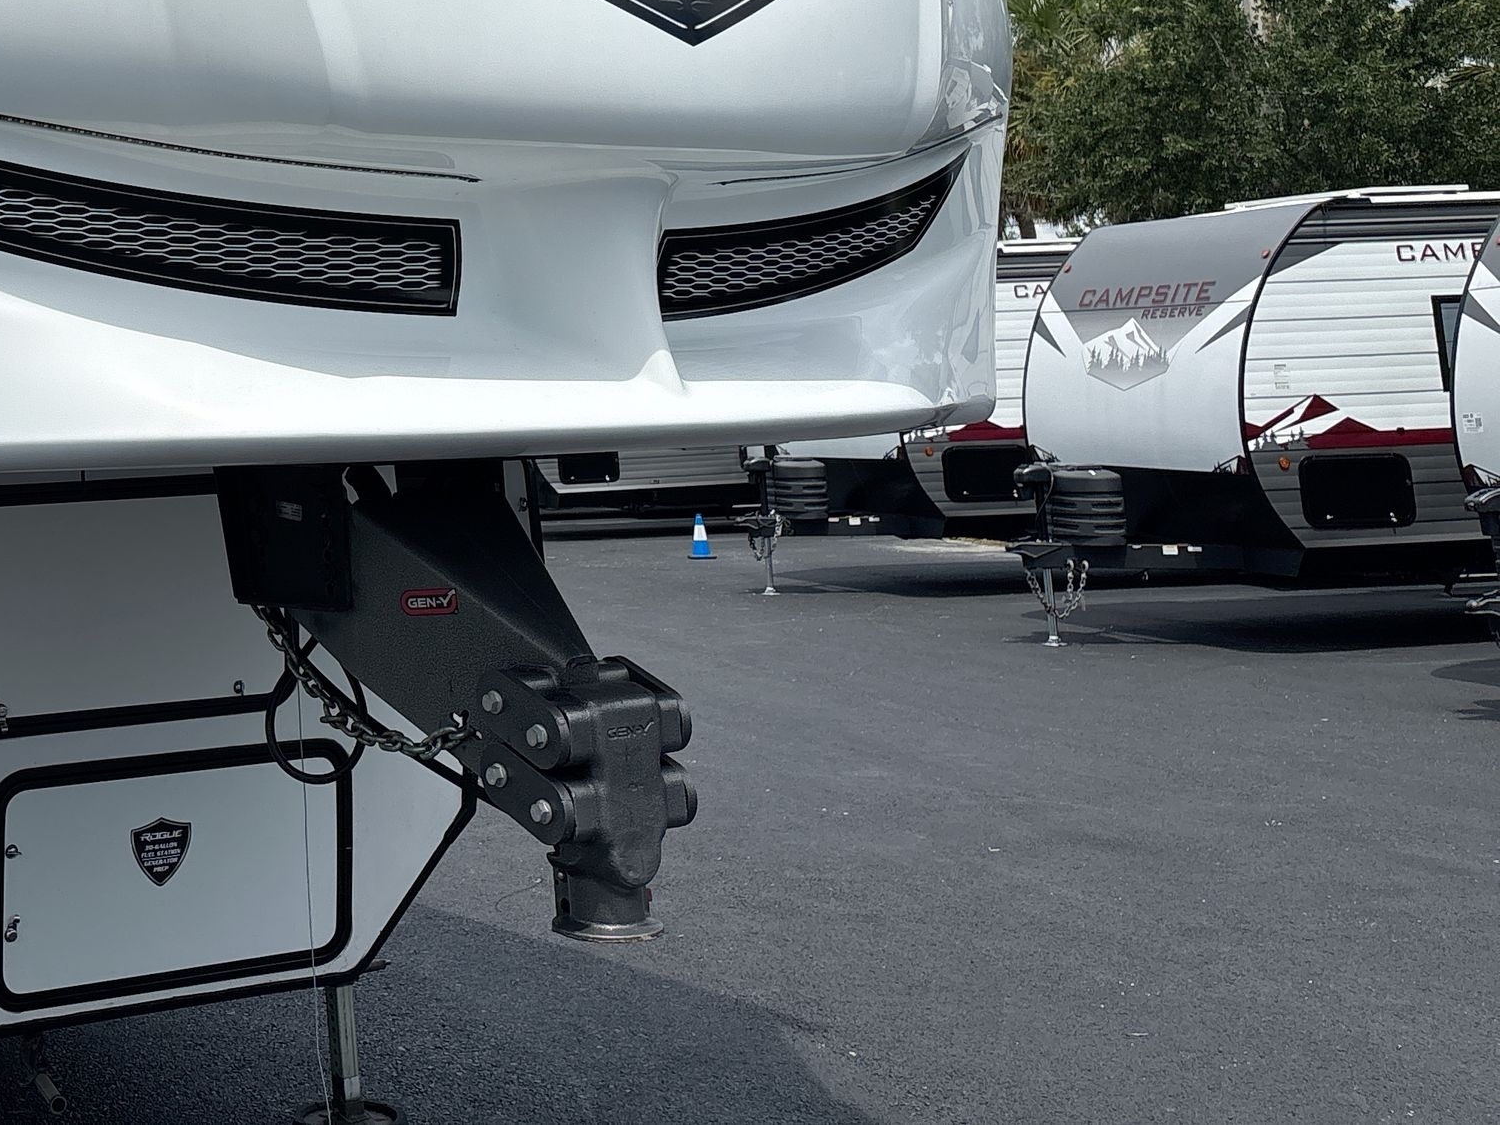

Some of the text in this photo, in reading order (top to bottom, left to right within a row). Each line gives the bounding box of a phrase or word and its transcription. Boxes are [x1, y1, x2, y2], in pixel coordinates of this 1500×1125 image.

[1078, 280, 1217, 309] CAMPSITE
[1140, 305, 1206, 321] RESERVE
[407, 589, 457, 608] GEN-Y
[140, 830, 183, 842] ROGUE
